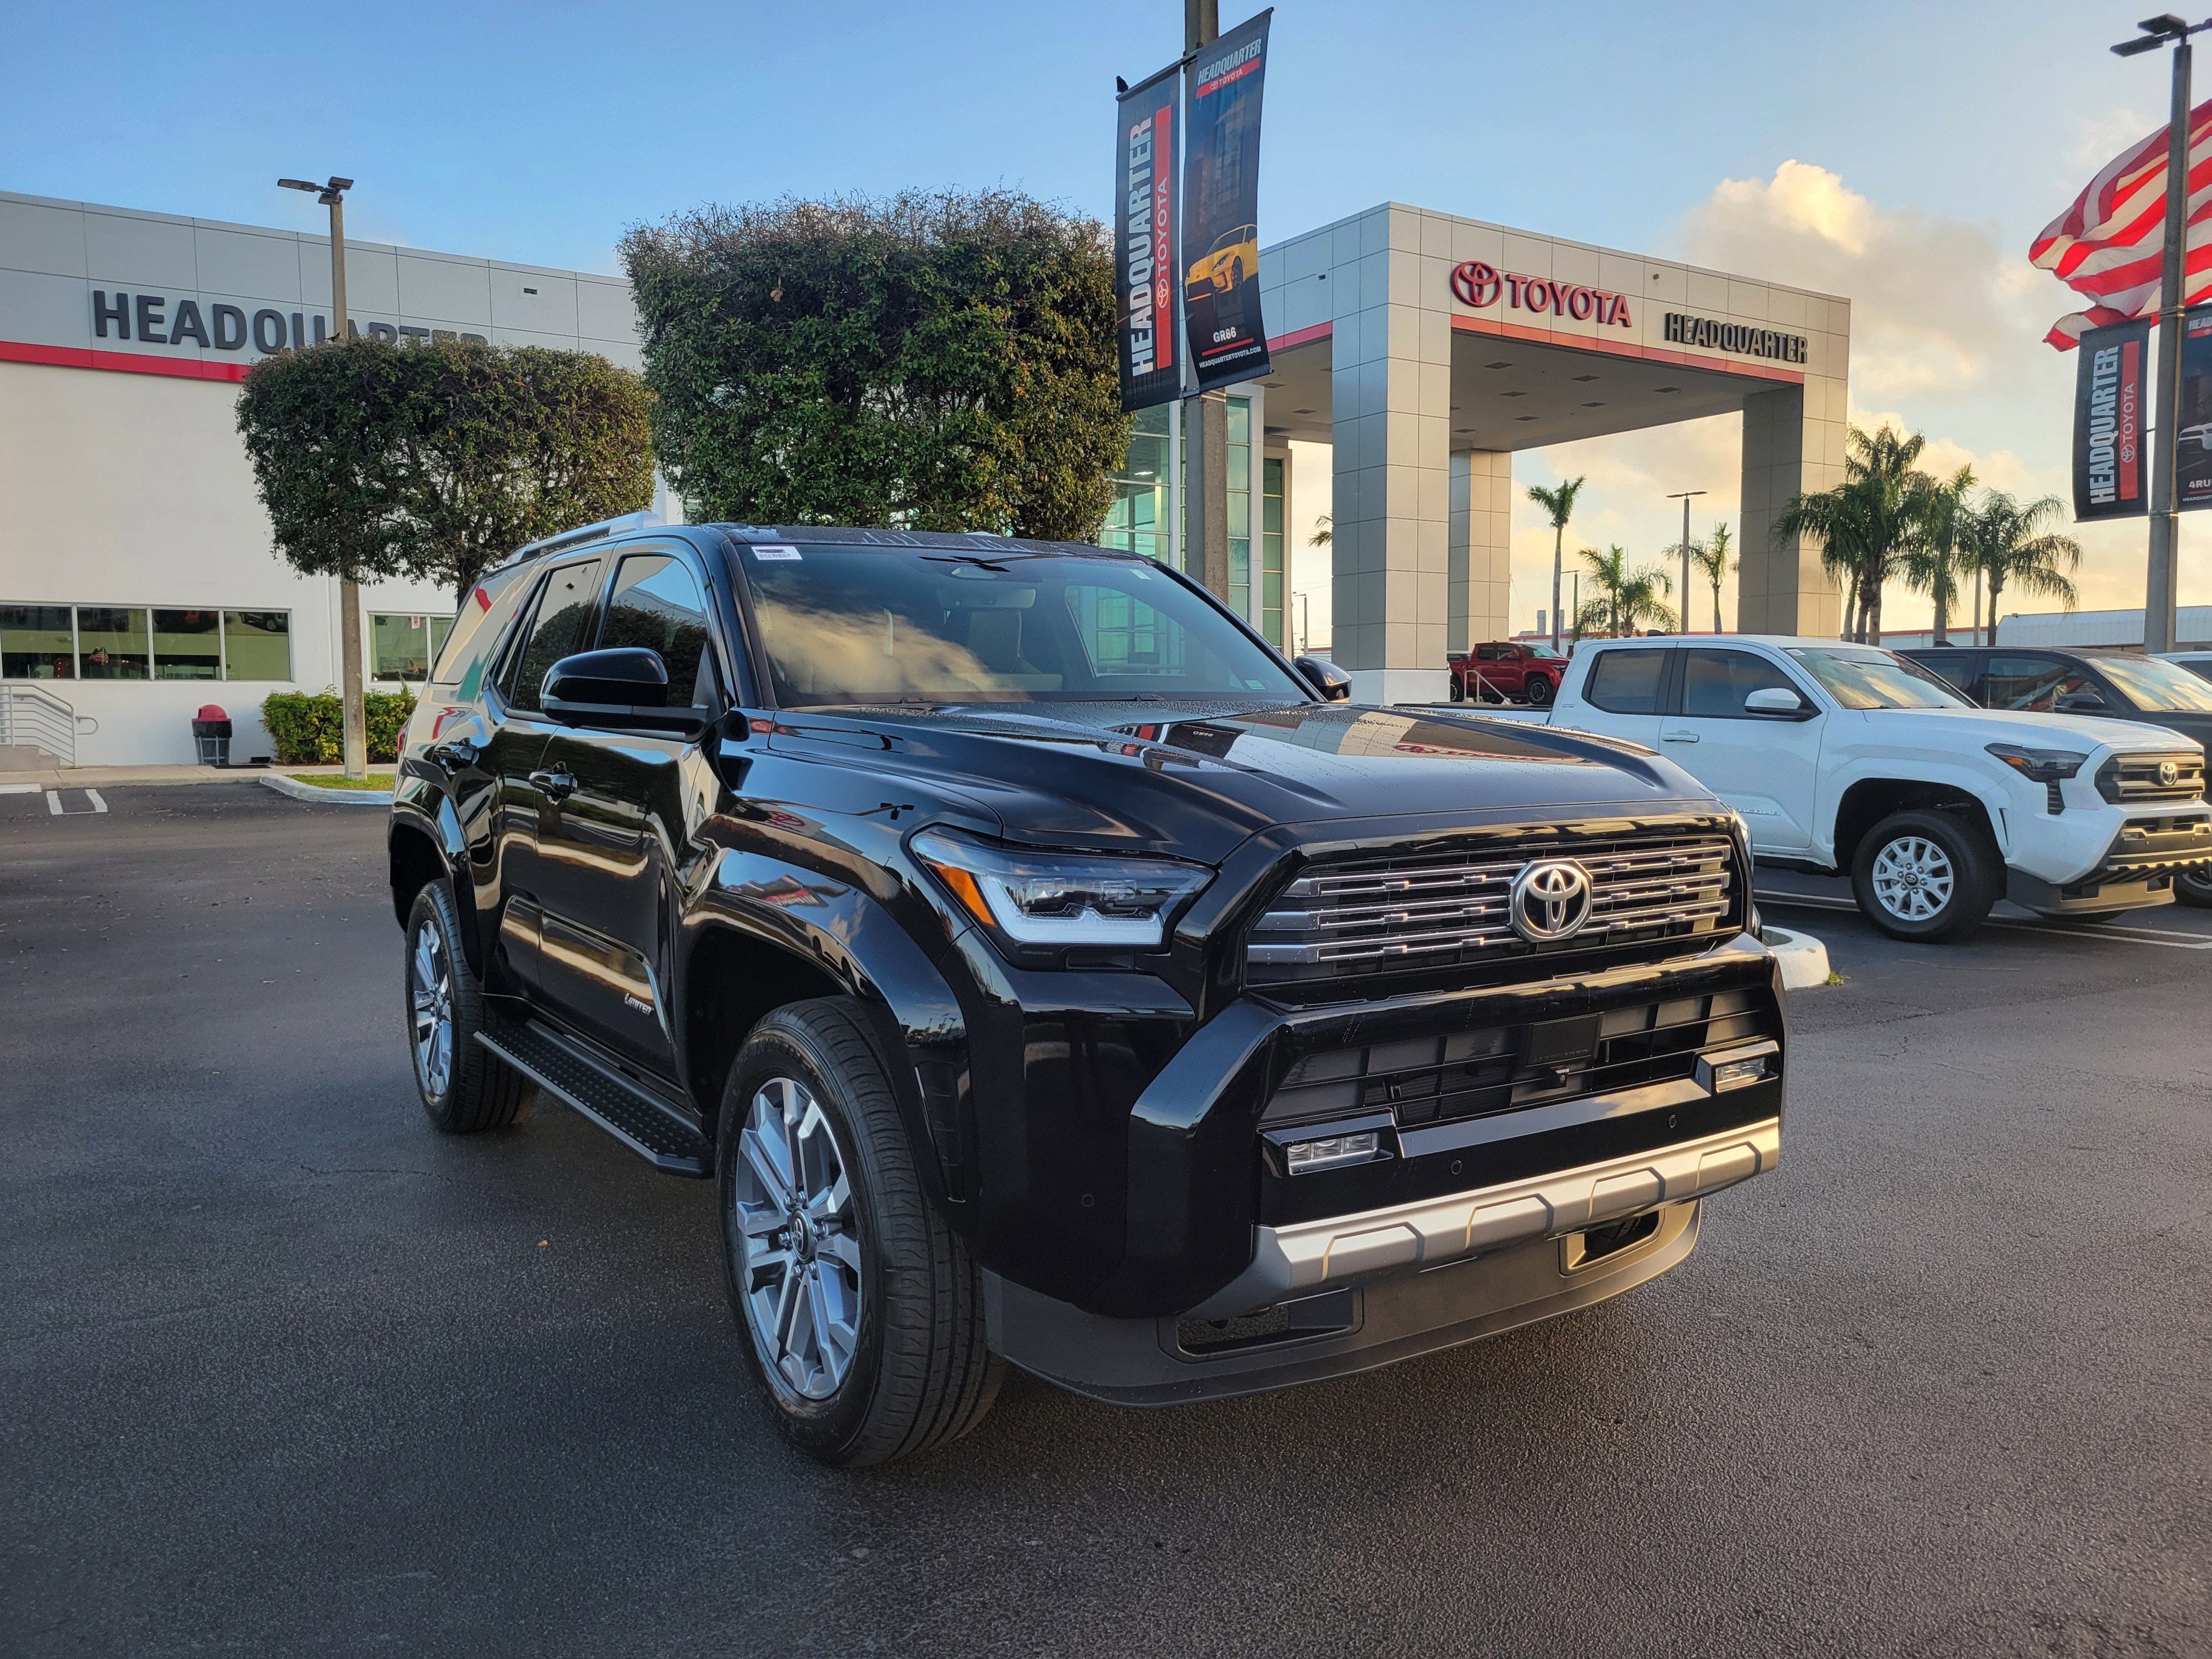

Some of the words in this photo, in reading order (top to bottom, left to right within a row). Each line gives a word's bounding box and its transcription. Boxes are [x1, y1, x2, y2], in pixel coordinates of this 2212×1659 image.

[1198, 38, 1262, 86] HEADQUARTER
[1218, 69, 1243, 86] TOYOTA
[1128, 116, 1153, 377] HEADQUARTER
[1158, 177, 1168, 276] TOYOTA
[1506, 274, 1632, 327] TOYOTA
[1199, 346, 1262, 369] HEADQUARTERTOYOTA.COM
[1213, 326, 1237, 343] GR86
[1664, 312, 1808, 363] HEADQUARTER
[2090, 346, 2119, 505] HEADQUARTER
[2123, 382, 2135, 443] TOYOTA
[2188, 478, 2212, 489] 4RU
